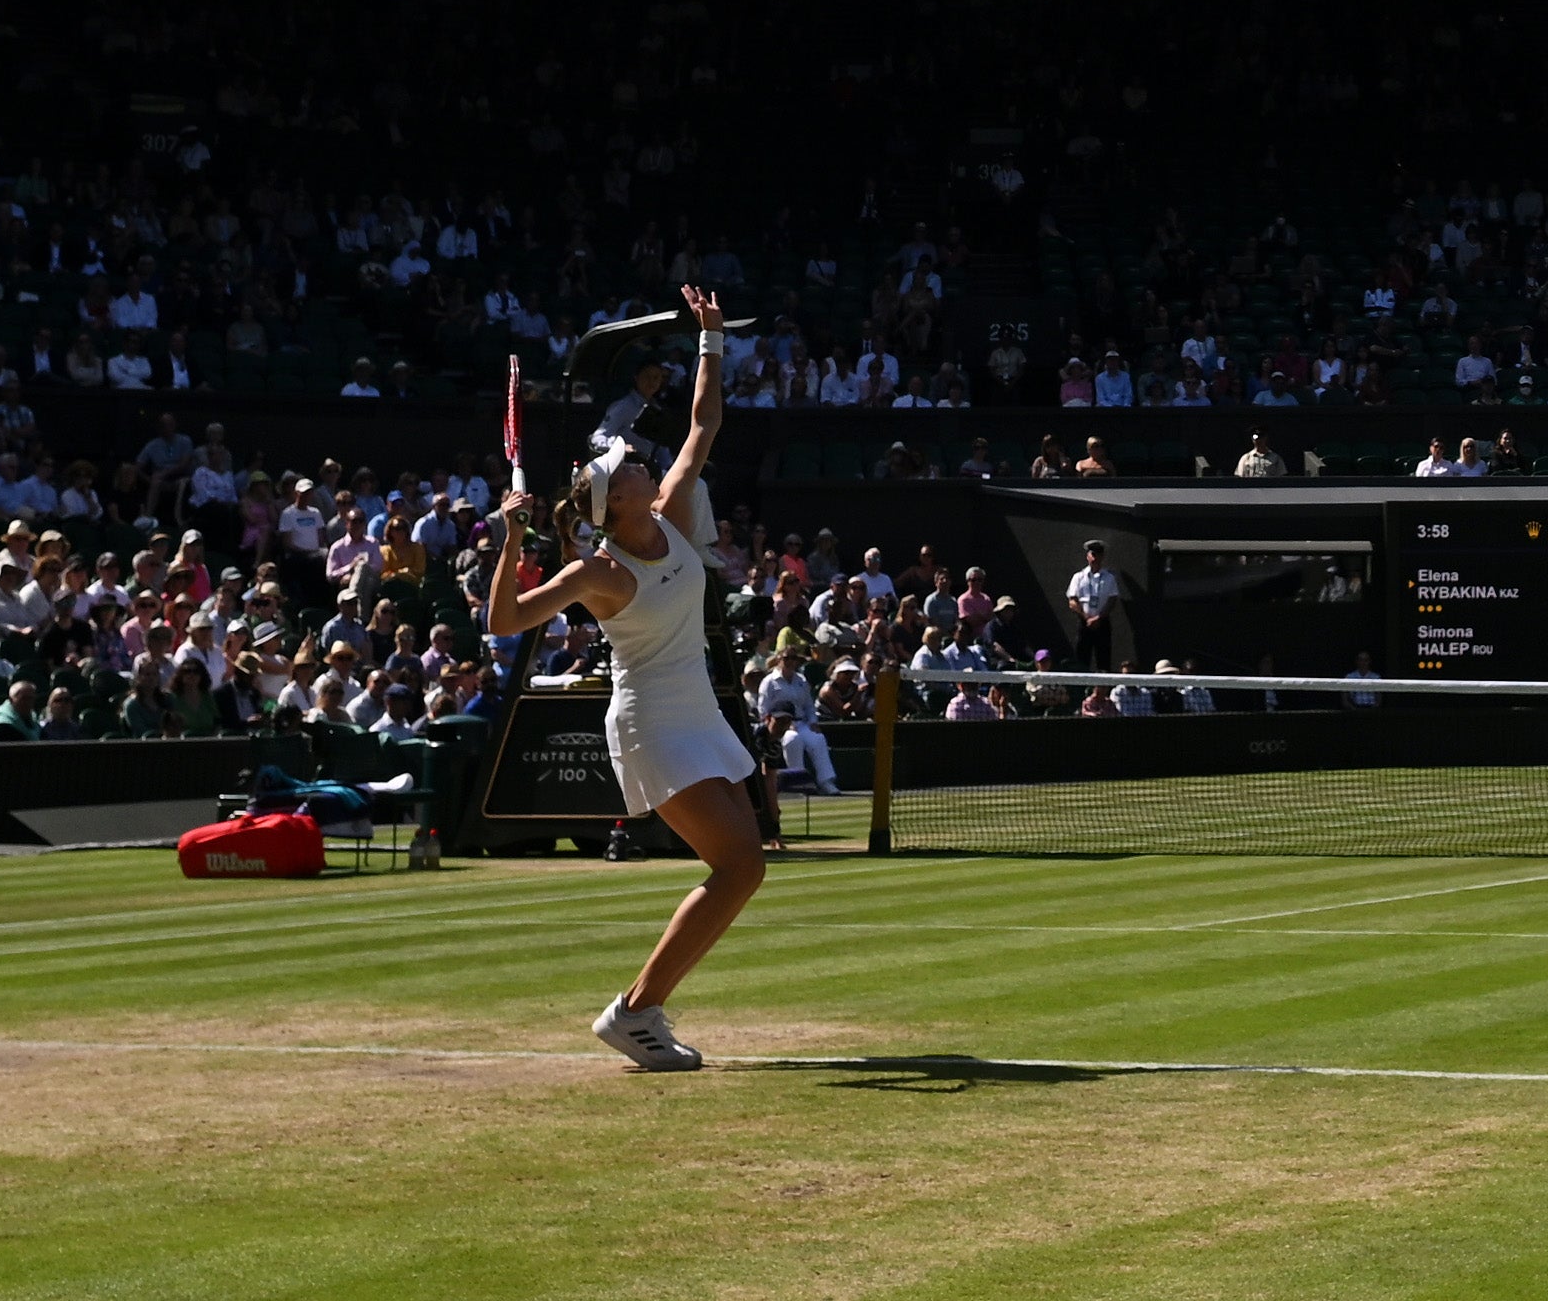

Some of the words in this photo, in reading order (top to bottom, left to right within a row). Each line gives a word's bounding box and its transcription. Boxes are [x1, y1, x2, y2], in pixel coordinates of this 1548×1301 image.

[1417, 523, 1450, 539] 3:58
[1418, 569, 1460, 583] Elena
[1418, 586, 1498, 600] RYBAKINA
[1499, 588, 1520, 599] KAZ
[1417, 624, 1474, 639] Simona
[1418, 642, 1470, 656] HALEP
[1472, 644, 1494, 655] ROU
[522, 751, 576, 763] CENTRE
[580, 751, 611, 763] COU
[557, 768, 588, 782] 100
[205, 852, 266, 872] Wilson
